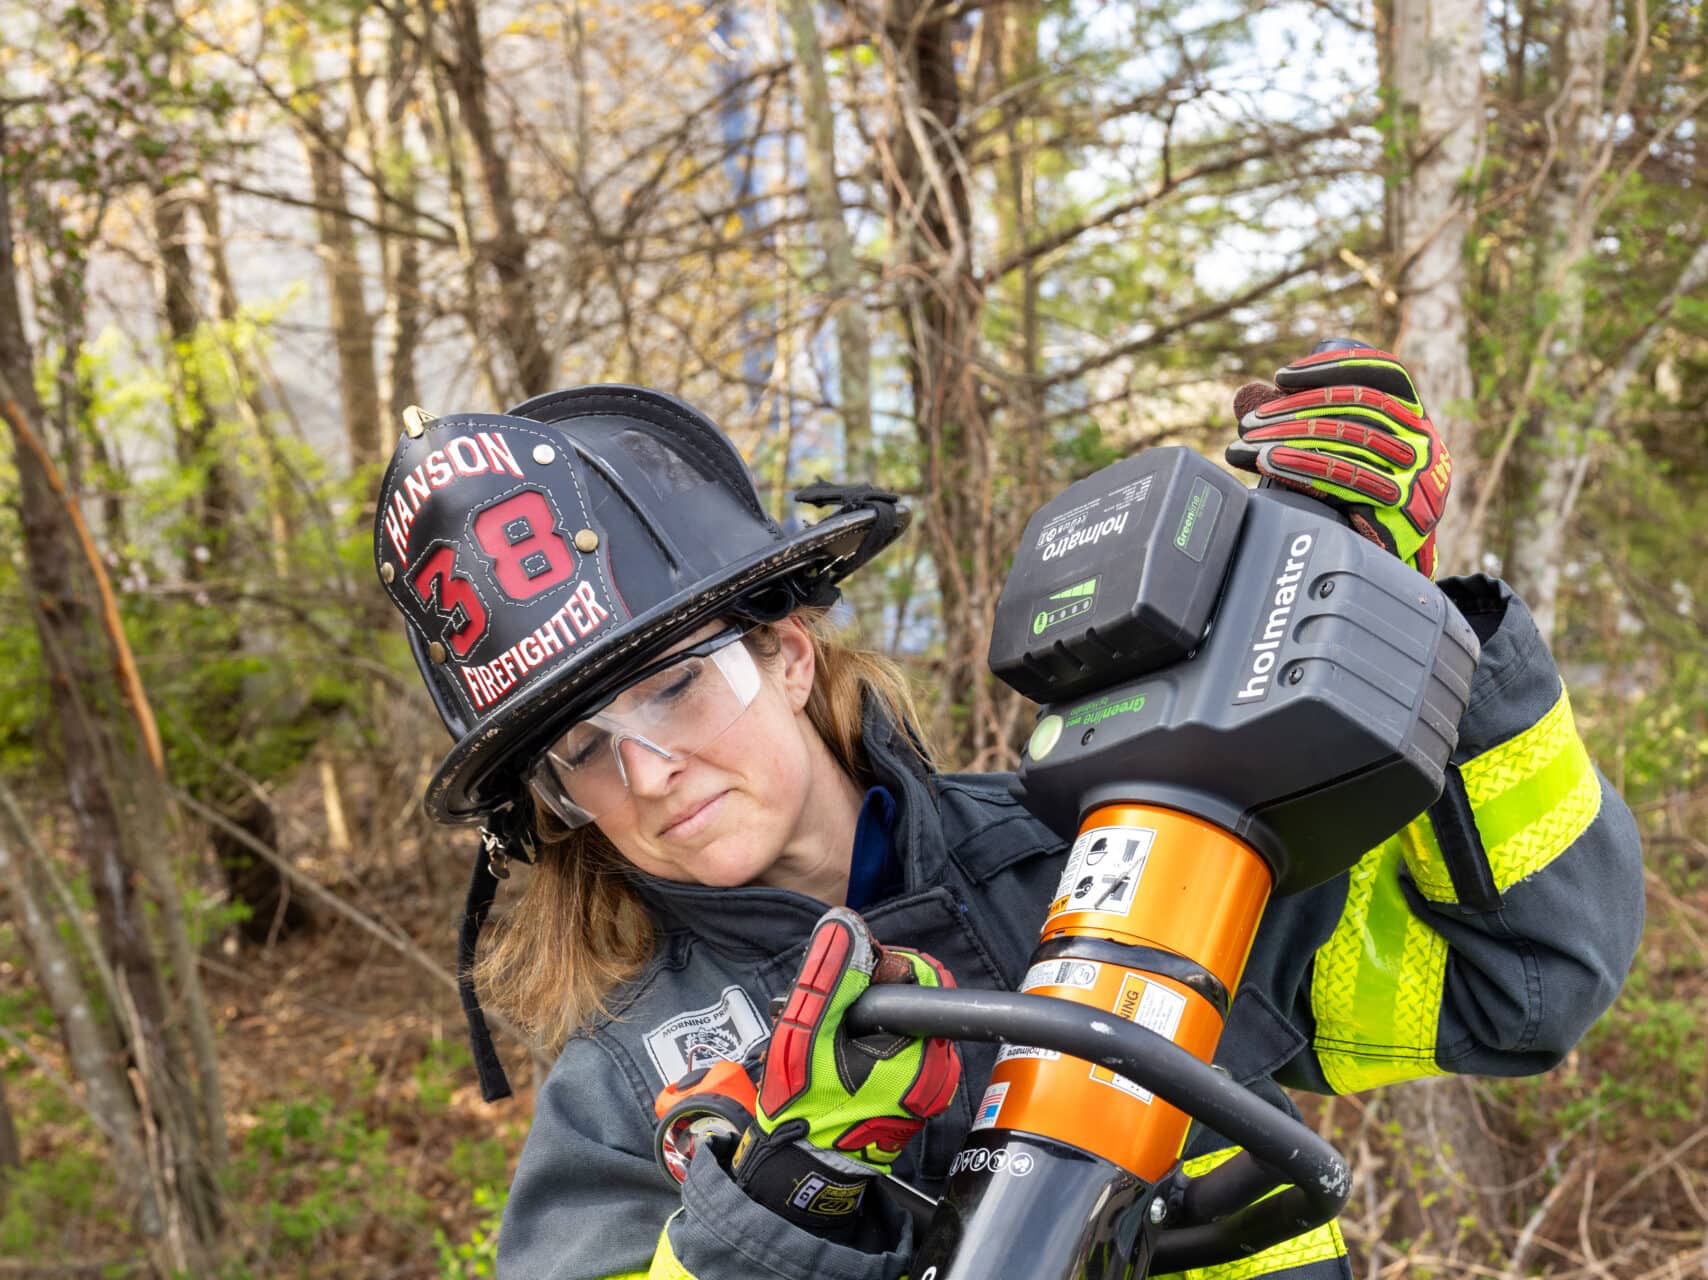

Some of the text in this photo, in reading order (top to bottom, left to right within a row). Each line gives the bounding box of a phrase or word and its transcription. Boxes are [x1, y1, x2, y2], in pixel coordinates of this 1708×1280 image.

[385, 432, 524, 567] HANSON
[1042, 511, 1126, 562] holmatro
[414, 491, 575, 655] 38
[1239, 533, 1313, 700] holmatro
[460, 580, 610, 709] FIREFIGHTER
[1083, 694, 1147, 724] Greenline
[661, 1015, 712, 1039] MORNING
